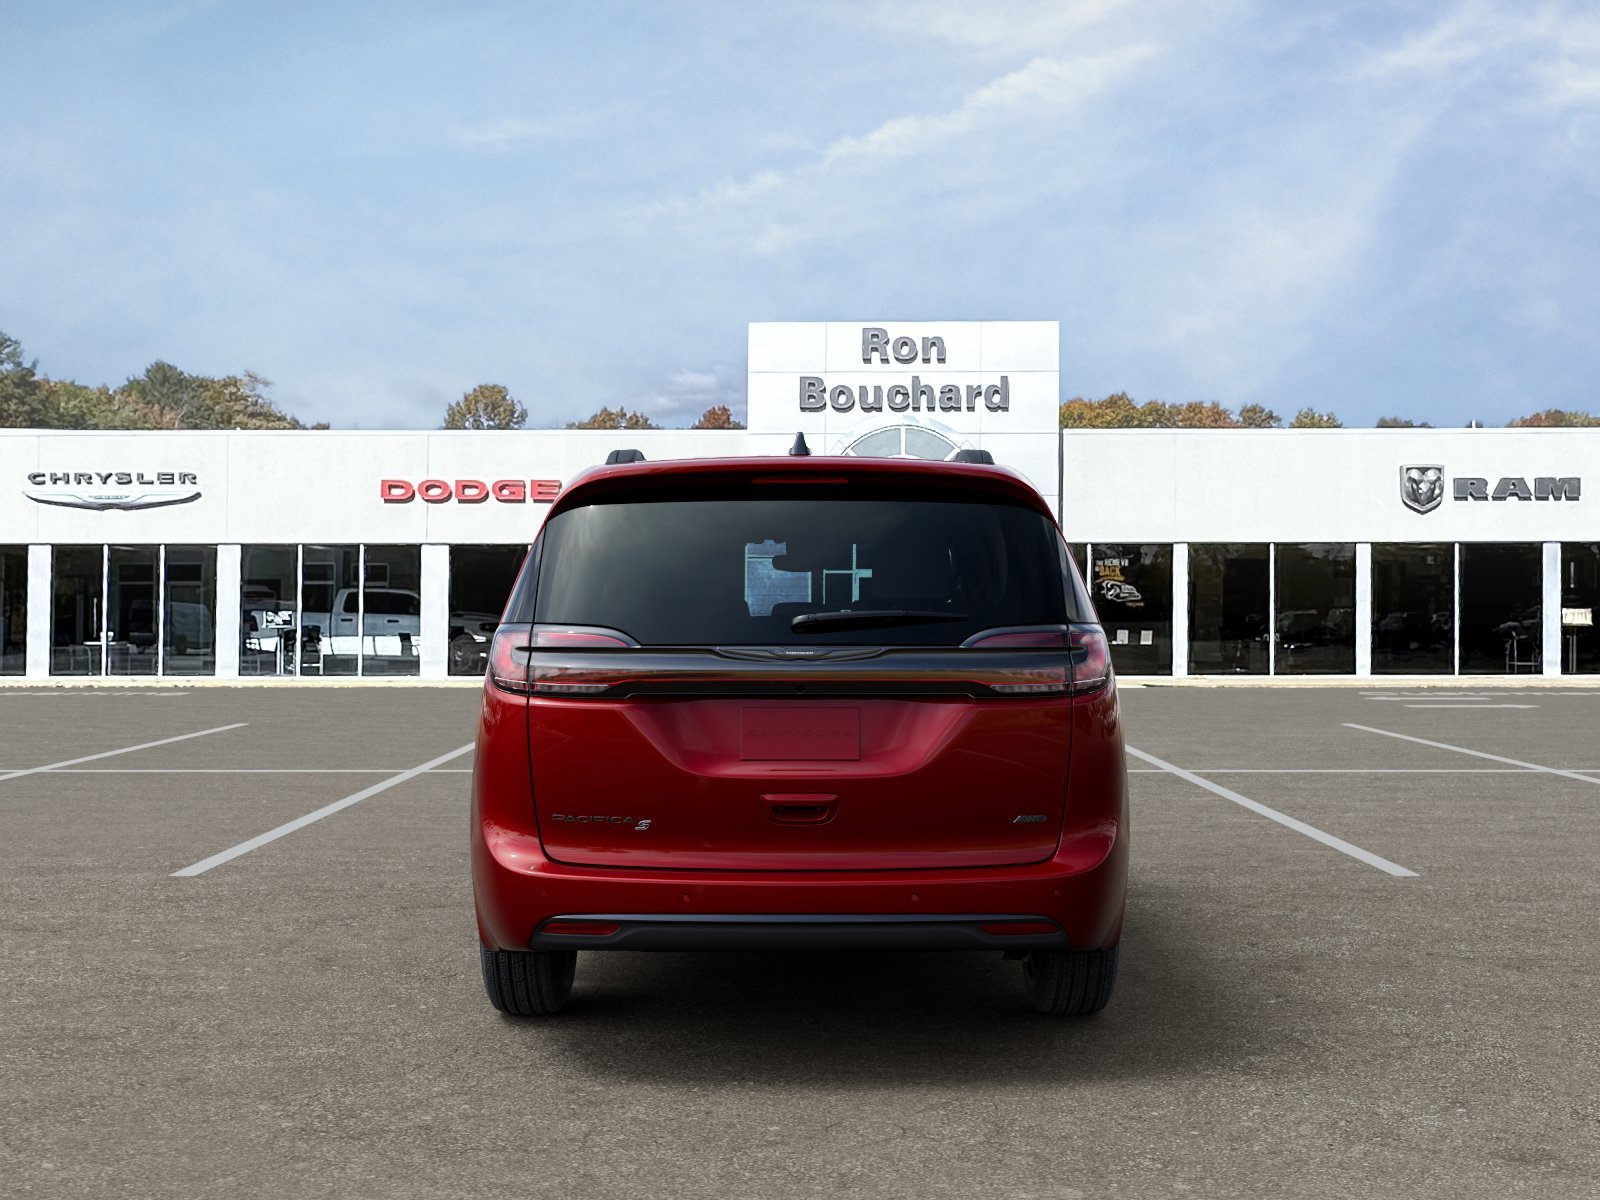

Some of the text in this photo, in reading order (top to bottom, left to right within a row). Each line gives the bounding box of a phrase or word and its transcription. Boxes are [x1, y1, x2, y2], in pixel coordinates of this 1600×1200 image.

[862, 327, 946, 364] Ron
[799, 376, 1010, 412] Bouchard
[27, 472, 198, 486] CHRYSLER
[1453, 477, 1581, 501] RAM
[381, 479, 562, 504] DODGE
[551, 813, 635, 824] PACIFICA
